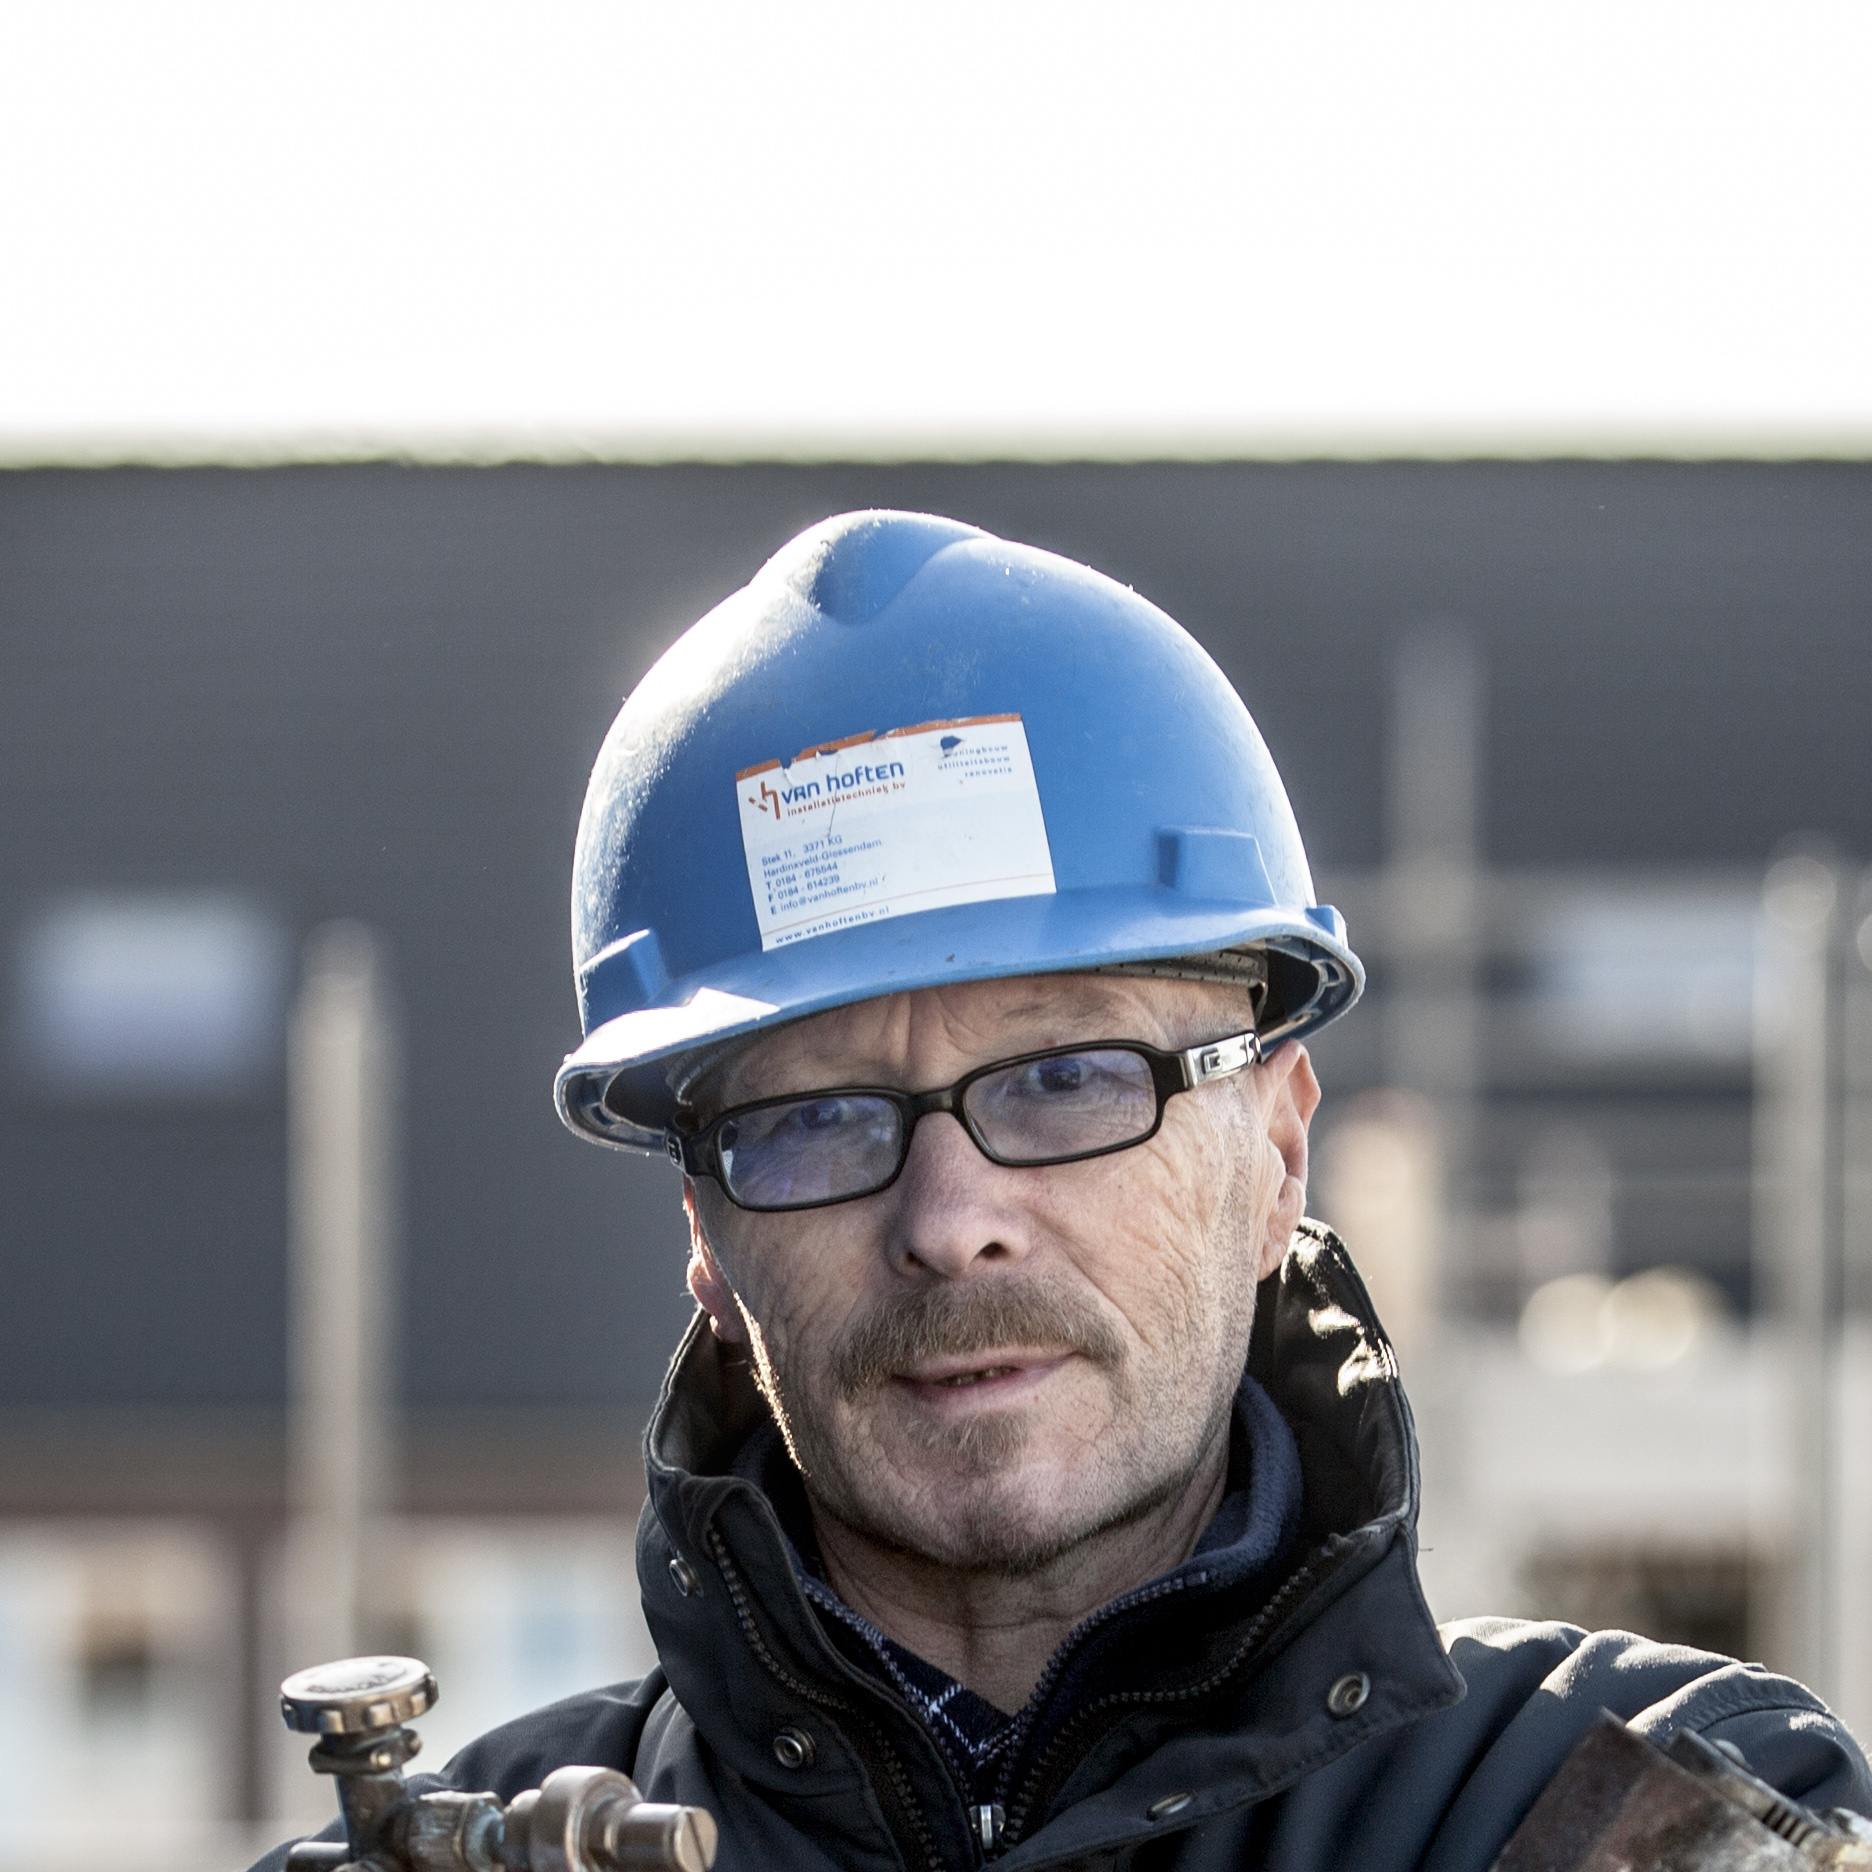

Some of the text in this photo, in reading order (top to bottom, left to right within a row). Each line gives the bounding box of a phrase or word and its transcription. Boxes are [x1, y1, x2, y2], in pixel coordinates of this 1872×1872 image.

[761, 853, 781, 867] Stek
[803, 840, 825, 854] 3371
[827, 834, 843, 847] KG
[770, 877, 879, 915] E info@vanhoftenbv.nl
[775, 873, 797, 888] 0184
[778, 886, 799, 900] 0184
[775, 905, 890, 944] www.vanhoftenbv.nl
